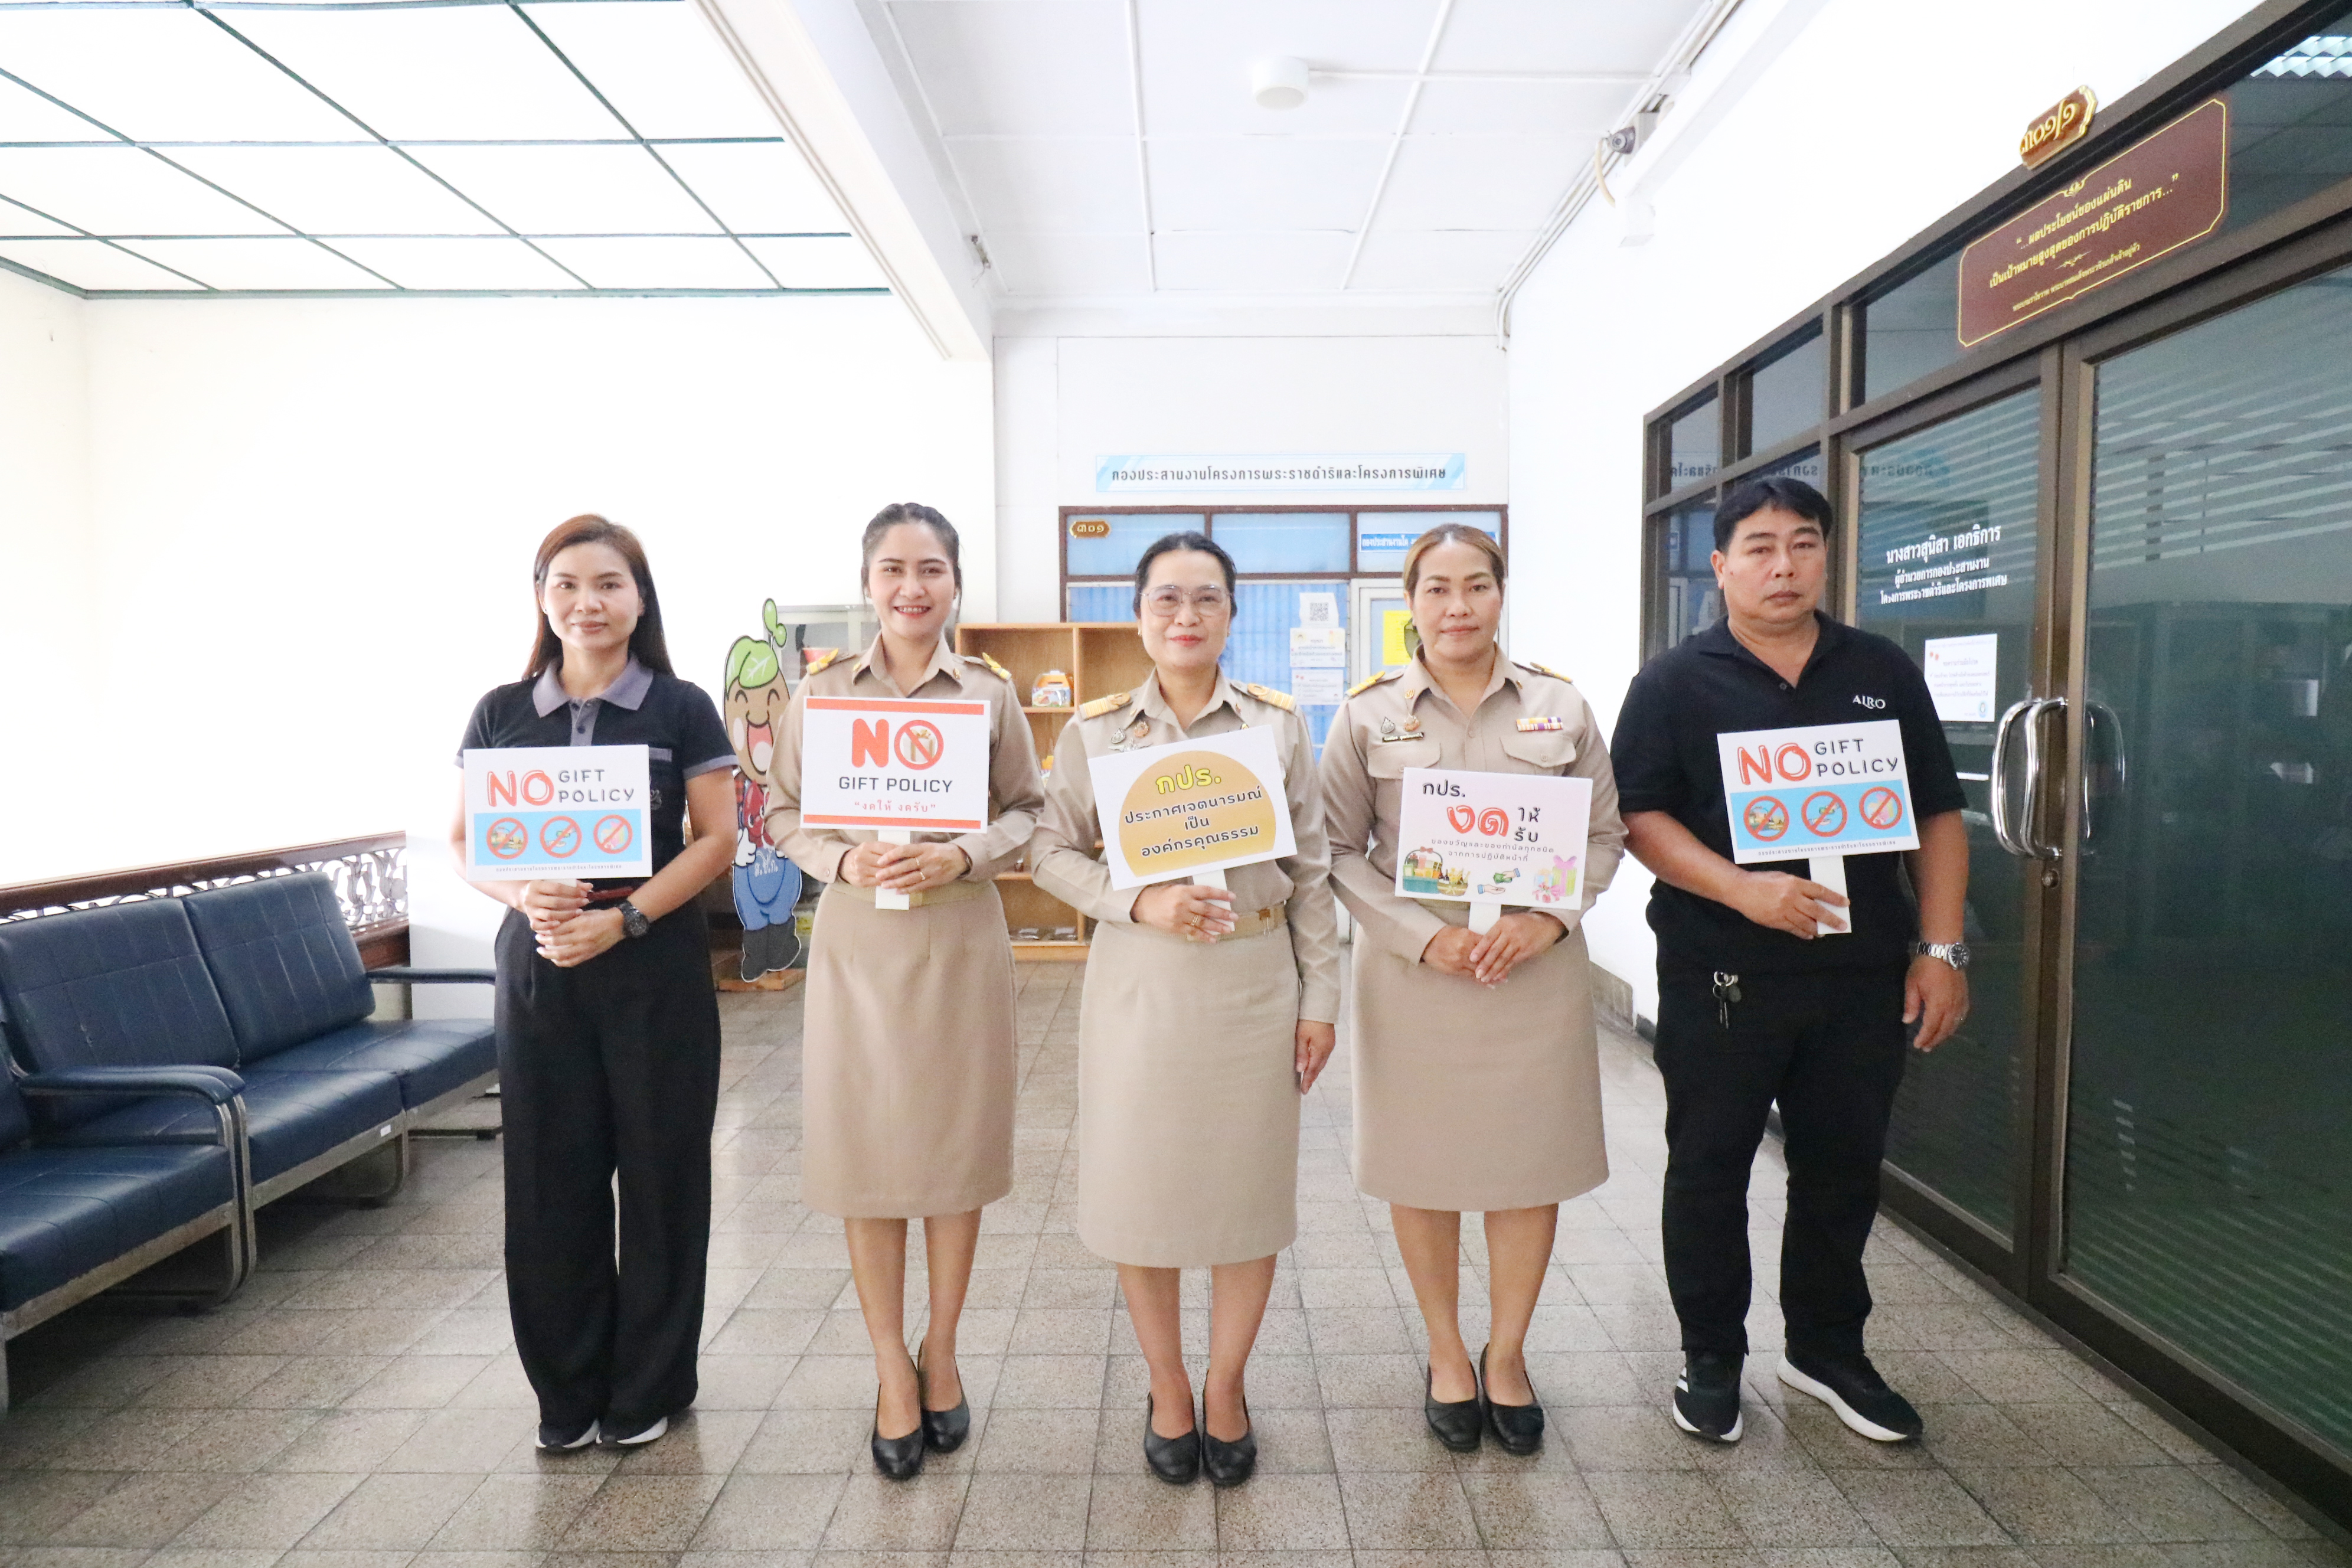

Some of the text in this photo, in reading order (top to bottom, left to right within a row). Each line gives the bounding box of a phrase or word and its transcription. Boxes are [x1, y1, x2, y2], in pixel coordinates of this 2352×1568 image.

[2020, 99, 2078, 155] ๓๐๑/๑
[1112, 465, 1446, 481] กองประสานงานโครงการพระราชดำริและโครงการพิเศษ
[1077, 524, 1105, 534] ๓๐๑
[1886, 523, 2002, 564] นางสาวสุนิสา เอกธิการ
[1853, 694, 1886, 710] ALRO
[1737, 739, 1864, 785] NO GIFT
[1816, 757, 1898, 777] POLICY
[487, 769, 605, 807] NO GIFT
[838, 776, 953, 793] GIFT POLICY
[1155, 765, 1222, 794] กปร.
[1422, 779, 1465, 798] กปร.
[558, 788, 635, 803] POLICY
[1125, 785, 1262, 824] ประกาศเจตนารมณ์
[1184, 815, 1210, 831] เป็น
[1446, 805, 1541, 837] งด ให้
[1142, 825, 1259, 857] องค์กรคุณธรรม
[1514, 826, 1539, 843] รับ
